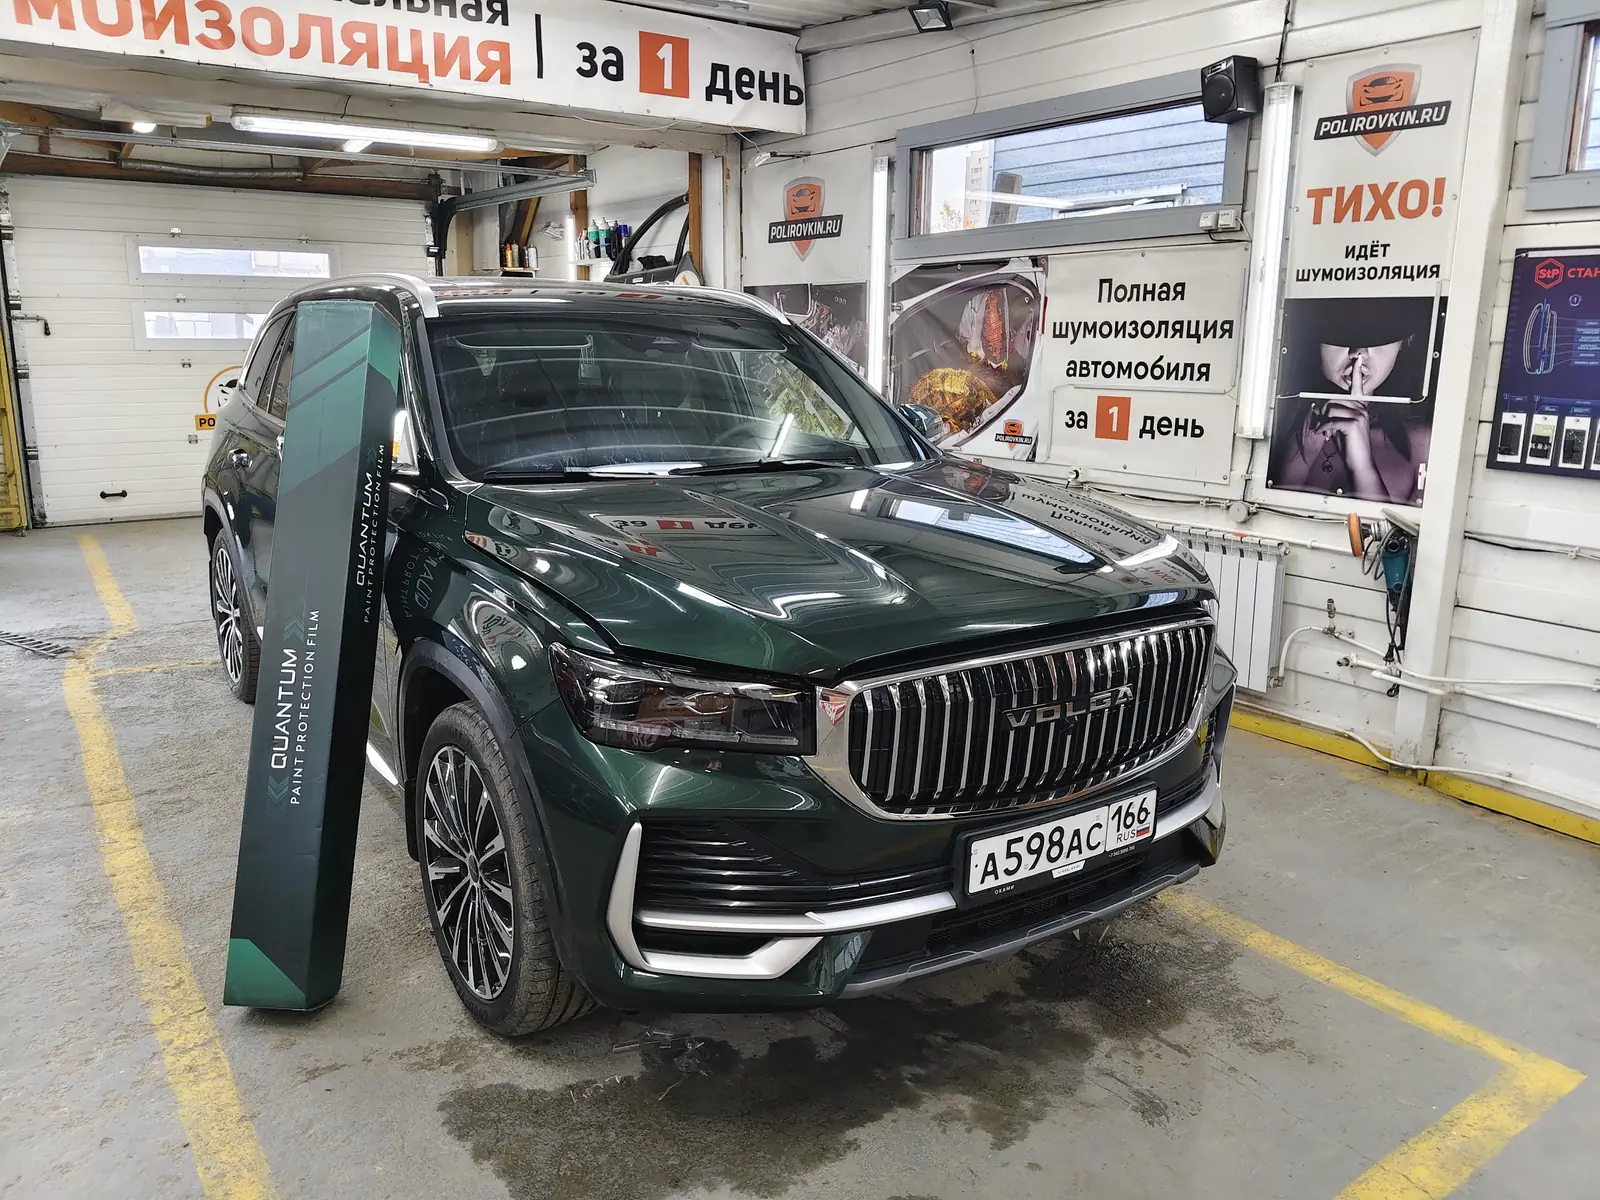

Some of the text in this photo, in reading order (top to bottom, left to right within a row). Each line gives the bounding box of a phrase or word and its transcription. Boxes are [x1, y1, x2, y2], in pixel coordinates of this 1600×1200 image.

[575, 41, 805, 106] за 1 день
[1319, 104, 1447, 137] POLIROVKIN.RU
[1306, 177, 1446, 225] ТИХО!
[770, 219, 840, 240] POLIROVKIN.RU
[1344, 240, 1390, 260] ИДЁТ
[1295, 264, 1441, 283] ШУМОИЗОЛЯЦИЯ
[1538, 268, 1560, 279] StP
[1097, 278, 1186, 304] Полная
[1052, 318, 1234, 345] шумоизоляция
[1065, 355, 1211, 383] автомобиля
[1064, 406, 1205, 440] за 1 день
[356, 471, 374, 587] QUANTUM
[364, 444, 385, 624] PAINT PROTECTION FILM
[270, 648, 298, 770] QUANTUM
[290, 610, 320, 805] PAINT PROTECTION FILM
[1003, 685, 1134, 728] VOLGA
[1111, 796, 1150, 833] 166
[1116, 831, 1136, 844] RUS
